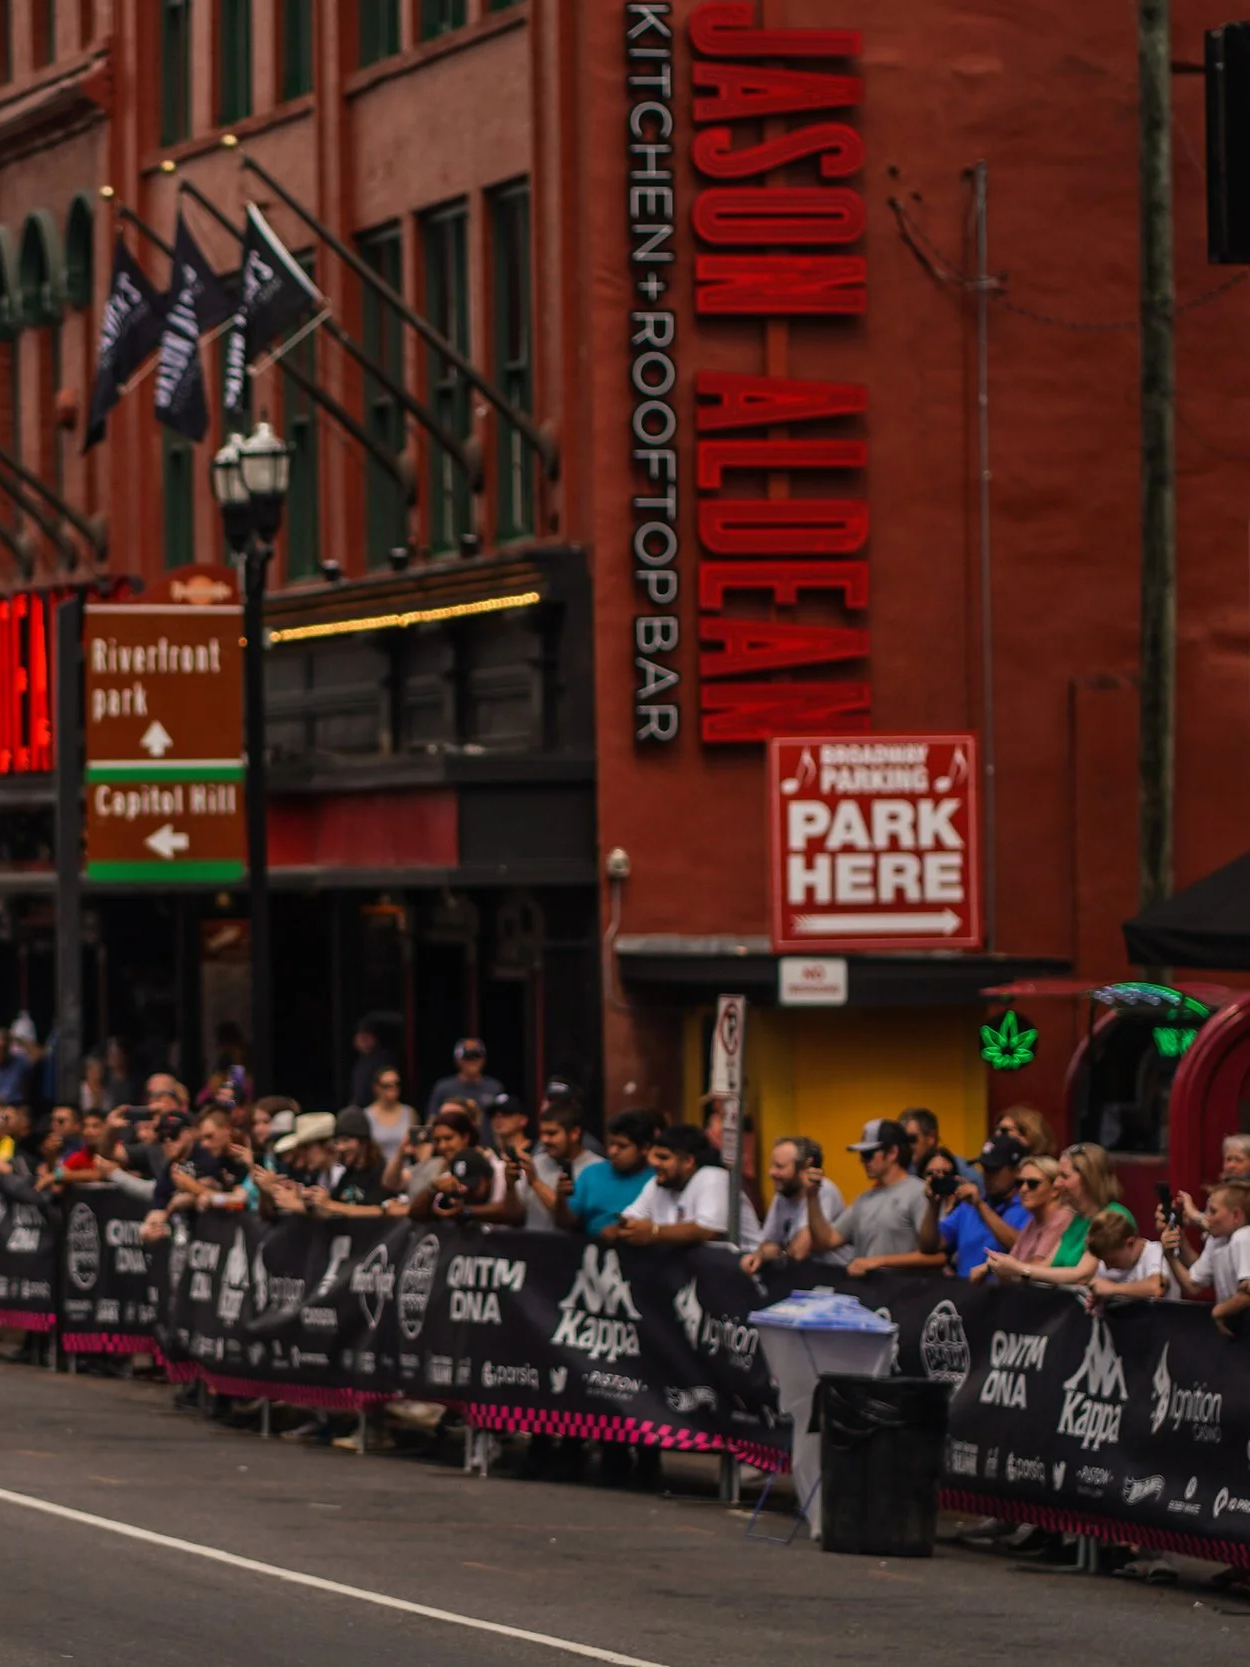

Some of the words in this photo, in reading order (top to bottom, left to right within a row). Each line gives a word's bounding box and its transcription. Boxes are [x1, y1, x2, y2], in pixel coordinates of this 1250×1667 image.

[627, 4, 674, 261] KITCHEN
[689, 2, 866, 314] JASON
[631, 312, 678, 603] ROOFTOP
[696, 370, 871, 742] ALDEAN
[92, 636, 221, 674] Riverfront
[636, 616, 680, 740] BAR
[92, 681, 148, 723] park
[819, 743, 928, 765] BROADWAY
[94, 784, 184, 821] Capitol
[189, 784, 237, 815] Hill
[819, 765, 929, 794] PARKING
[787, 798, 964, 851] PARK
[787, 852, 964, 905] HERE
[447, 1255, 527, 1292] QNTM
[450, 1290, 501, 1325] DNA
[551, 1307, 641, 1363] Kappa
[990, 1330, 1049, 1372] QNTM
[979, 1371, 1028, 1410] DNA
[1057, 1388, 1123, 1451] Kappa
